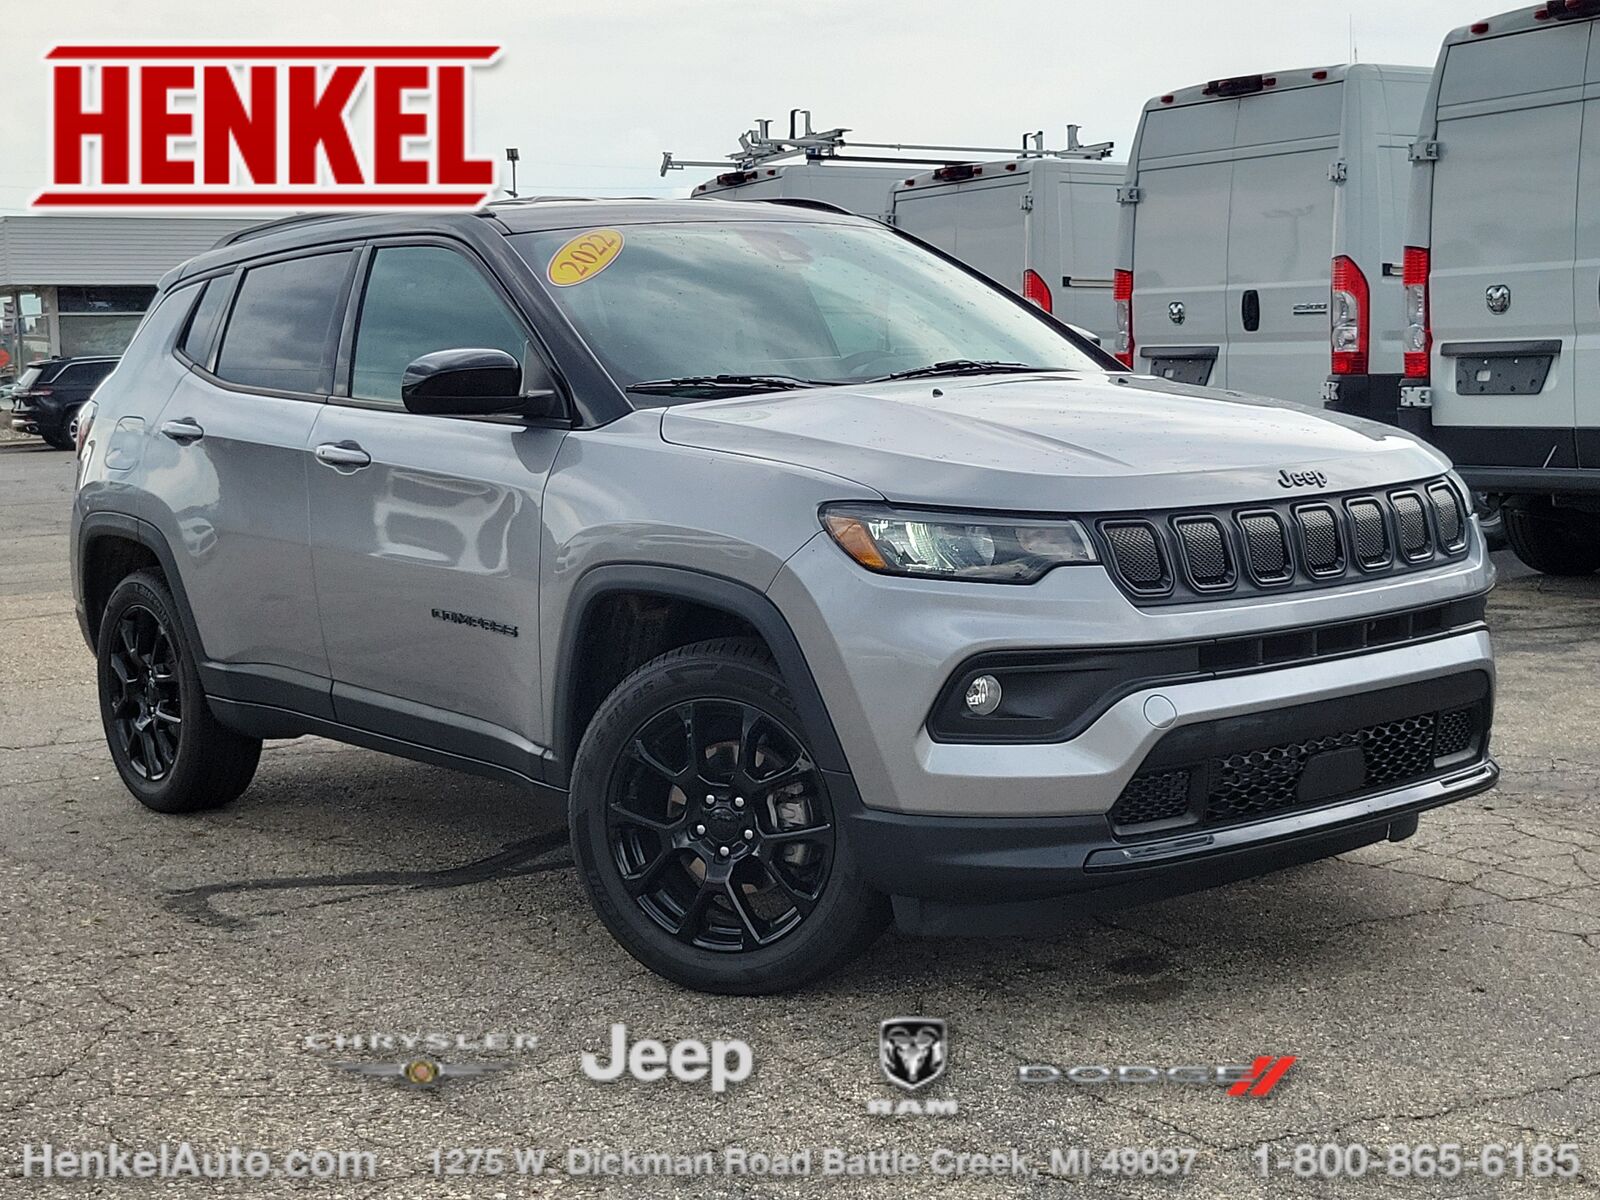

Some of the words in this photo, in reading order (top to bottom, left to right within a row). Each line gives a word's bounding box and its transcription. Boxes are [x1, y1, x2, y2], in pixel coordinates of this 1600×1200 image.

[559, 234, 616, 276] 2022
[1277, 469, 1328, 489] Jeep
[431, 608, 519, 638] COMPASS
